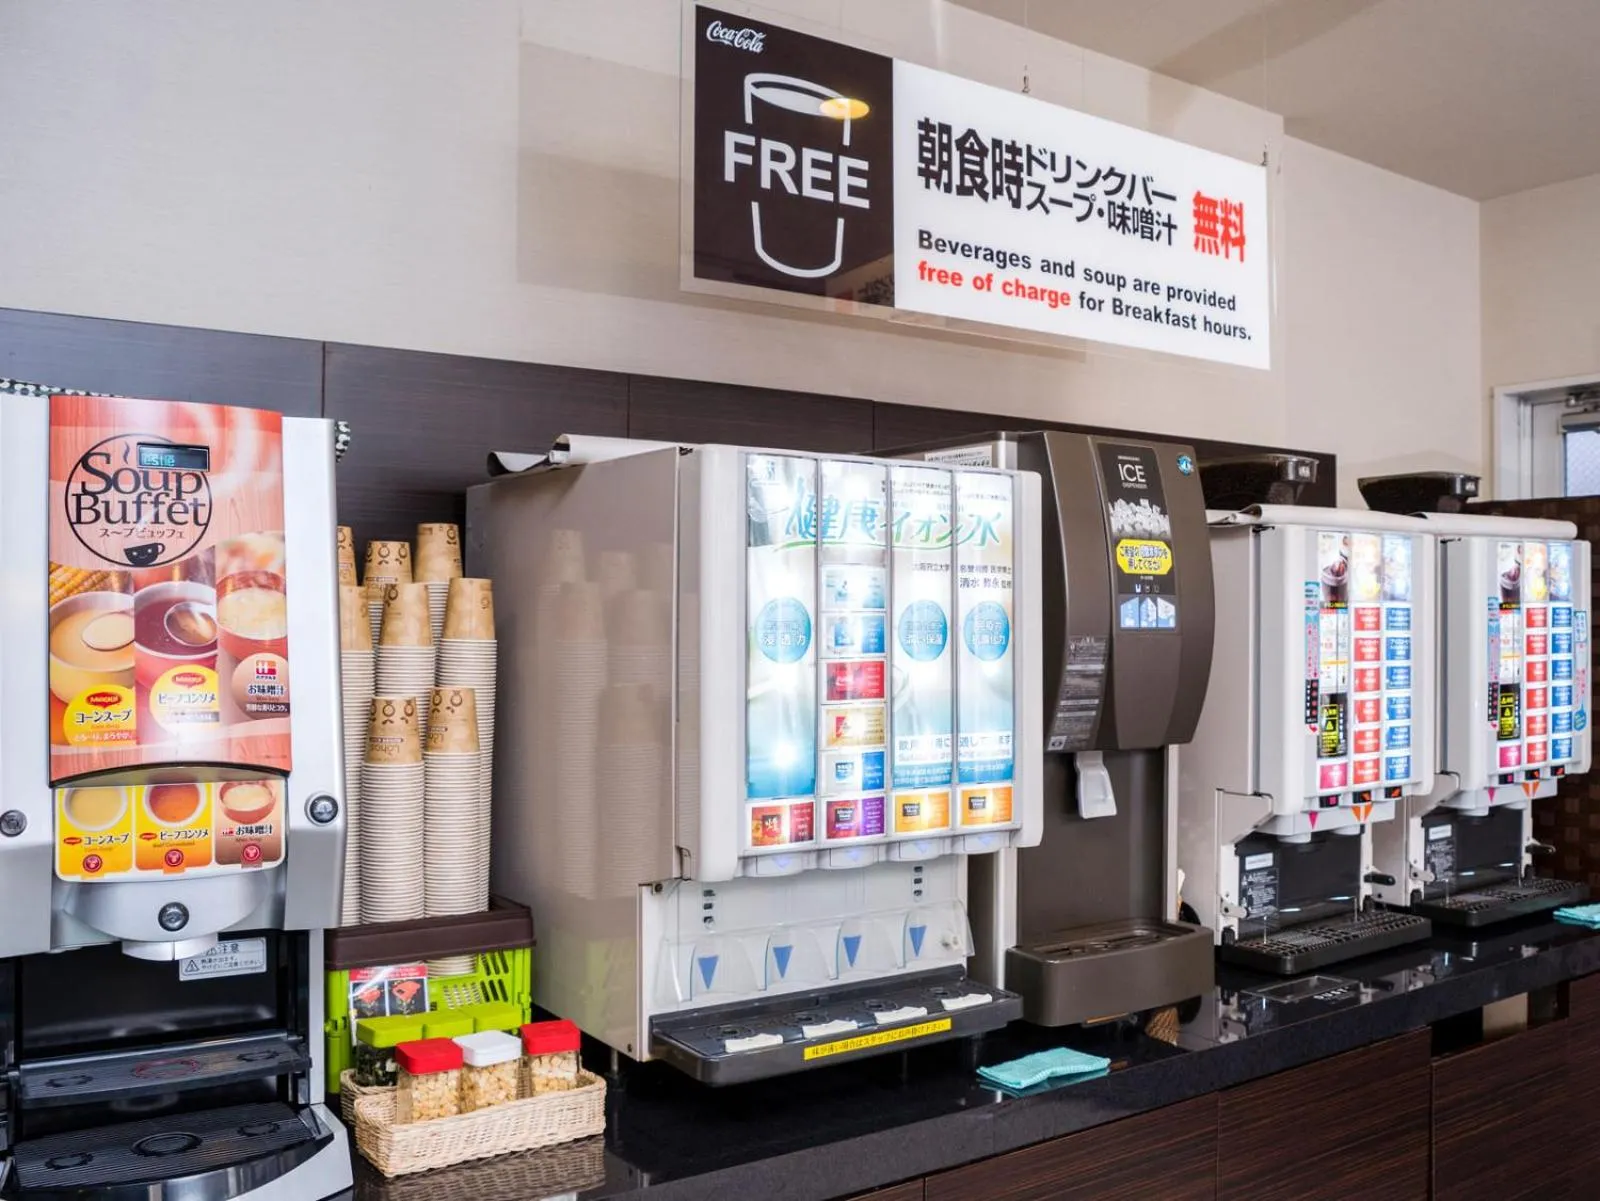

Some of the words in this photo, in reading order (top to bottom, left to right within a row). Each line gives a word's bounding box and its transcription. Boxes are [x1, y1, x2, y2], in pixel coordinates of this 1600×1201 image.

[707, 20, 767, 53] Coca-Cola
[724, 130, 870, 209] FREE
[917, 116, 1024, 210] 朝食時
[1026, 143, 1178, 205] ドリンクバー
[1026, 181, 1178, 247] スープ・味噌汁
[1192, 189, 1246, 263] 無料
[918, 229, 1032, 270] Beverages
[1040, 256, 1075, 278] and
[1083, 265, 1127, 292] soup
[1133, 276, 1161, 296] are
[1166, 282, 1236, 311] provided
[918, 261, 963, 287] free
[972, 272, 993, 292] of
[1002, 278, 1072, 309] charge
[1078, 291, 1104, 312] for
[1112, 298, 1197, 331] Breakfast
[1203, 315, 1252, 341] hours.
[81, 452, 204, 501] Soup
[1117, 463, 1147, 483] ICE
[72, 491, 209, 527] Buffet
[75, 709, 133, 724] コーンスープ
[84, 832, 129, 846] コーンスープ
